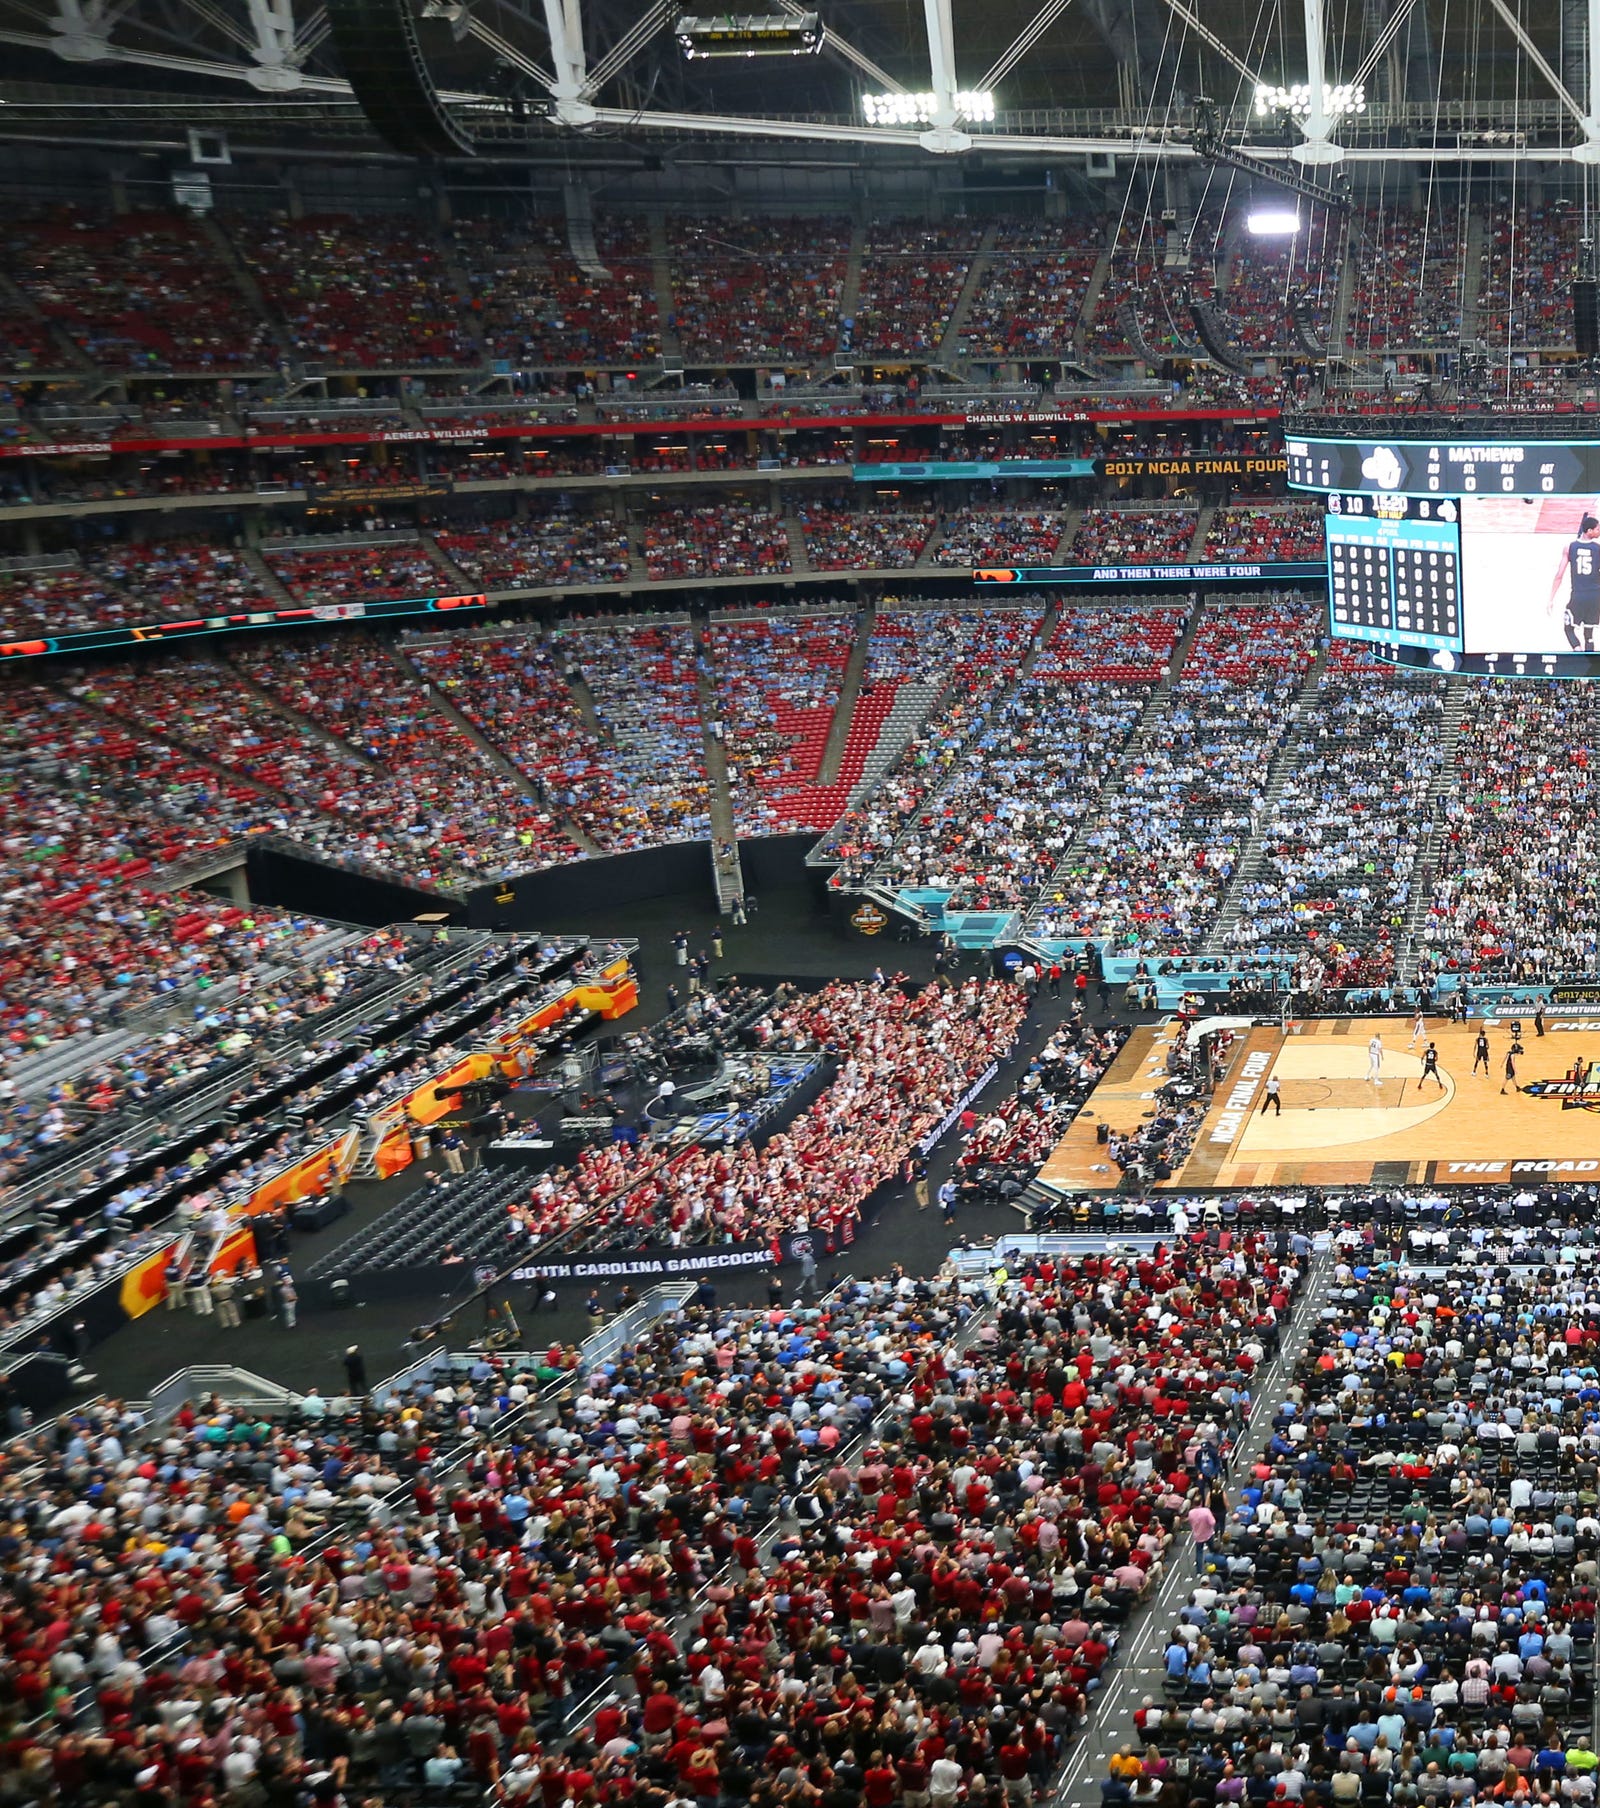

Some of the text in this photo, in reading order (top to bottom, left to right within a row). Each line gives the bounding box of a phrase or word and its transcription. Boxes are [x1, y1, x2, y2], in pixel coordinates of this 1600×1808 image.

[966, 414, 1011, 423] CHARLES
[1013, 414, 1026, 422] W.
[1028, 413, 1072, 422] BIDWILL,
[383, 431, 430, 440] AENEAS
[432, 429, 489, 438] WILLIAMS
[1429, 447, 1524, 462] 4 MATHEWS
[1105, 459, 1287, 475] 2017 NCAA FINAL FOUR
[1429, 476, 1553, 491] 0 0 0 0
[1346, 496, 1363, 514] 10
[1419, 500, 1430, 518] 8
[1093, 566, 1261, 580] AND THEN THERE WERE FOUR
[1576, 556, 1592, 575] 15
[1209, 1051, 1272, 1143] NCAA FINAL FOUR
[1448, 1161, 1508, 1173] THE
[1511, 1160, 1600, 1173] ROAD
[574, 1259, 663, 1277] CAROLINA
[667, 1249, 775, 1273] GAMECOCKS
